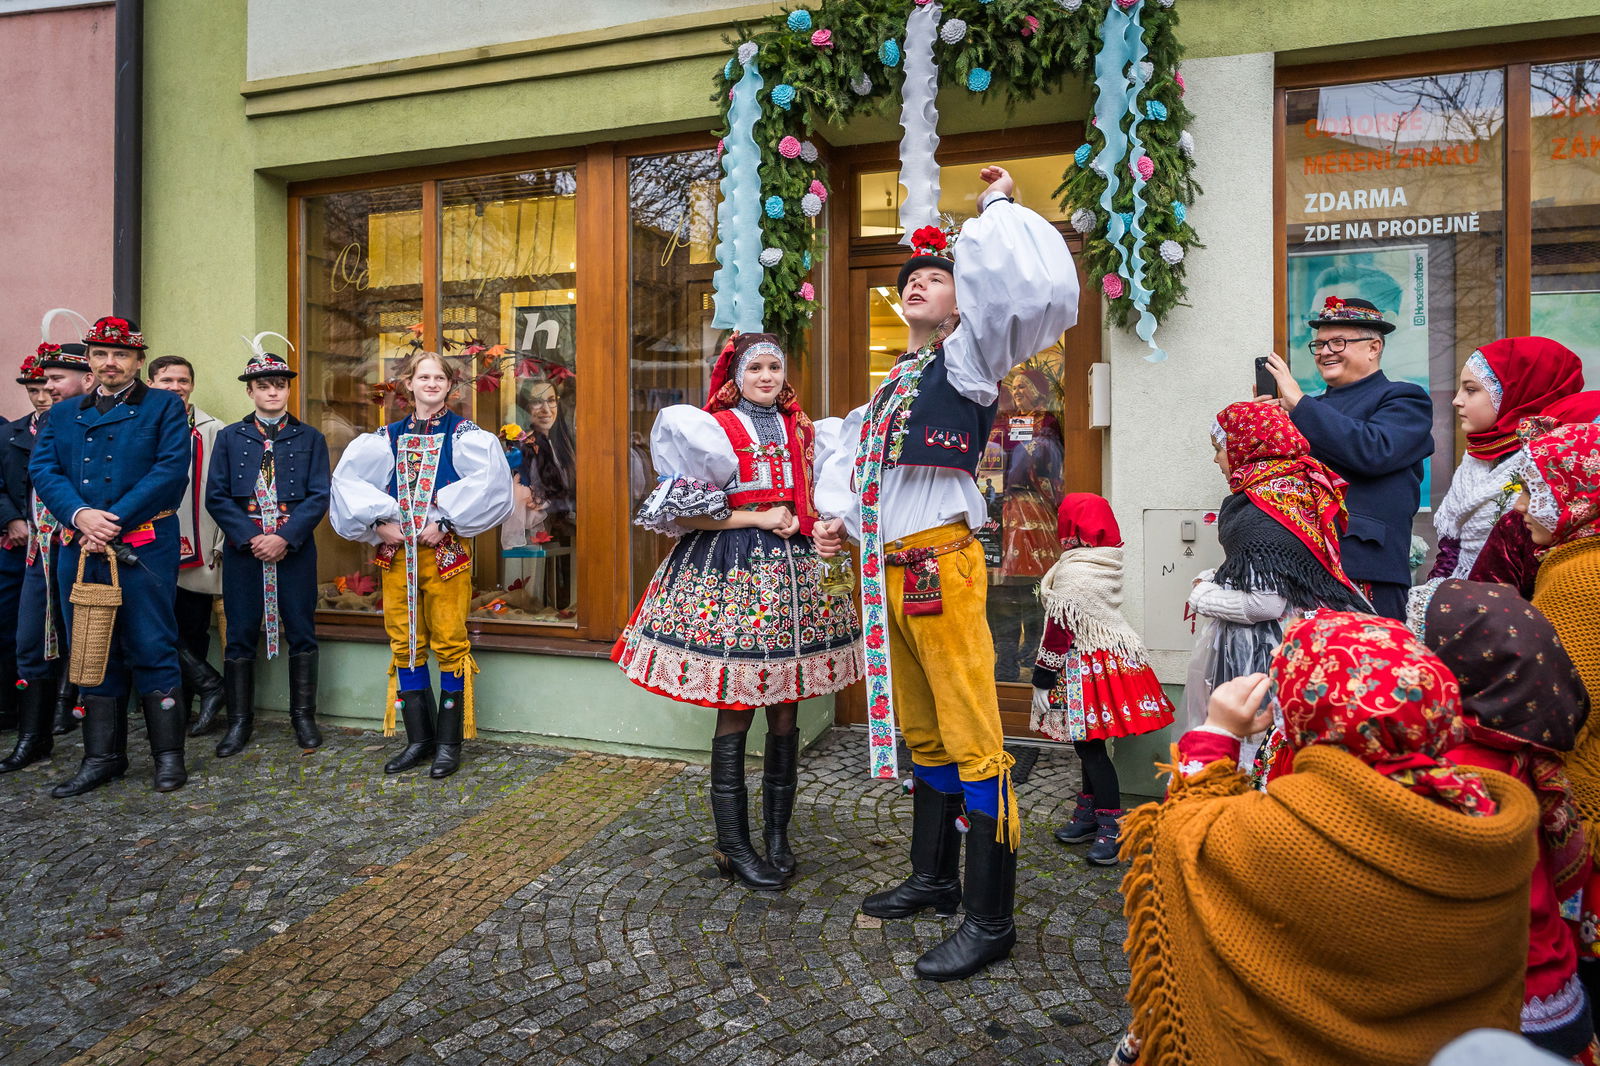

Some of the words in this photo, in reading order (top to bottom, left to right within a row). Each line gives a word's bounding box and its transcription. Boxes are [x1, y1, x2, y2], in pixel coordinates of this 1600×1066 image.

[1304, 104, 1424, 139] ODBORNÉ
[1396, 143, 1480, 169] ZRAKU
[1303, 186, 1408, 214] ZDARMA
[1304, 224, 1342, 242] ZDE
[1345, 222, 1373, 240] NA
[1377, 211, 1480, 238] PRODEJNĚ
[1413, 256, 1424, 315] Horsefeathers
